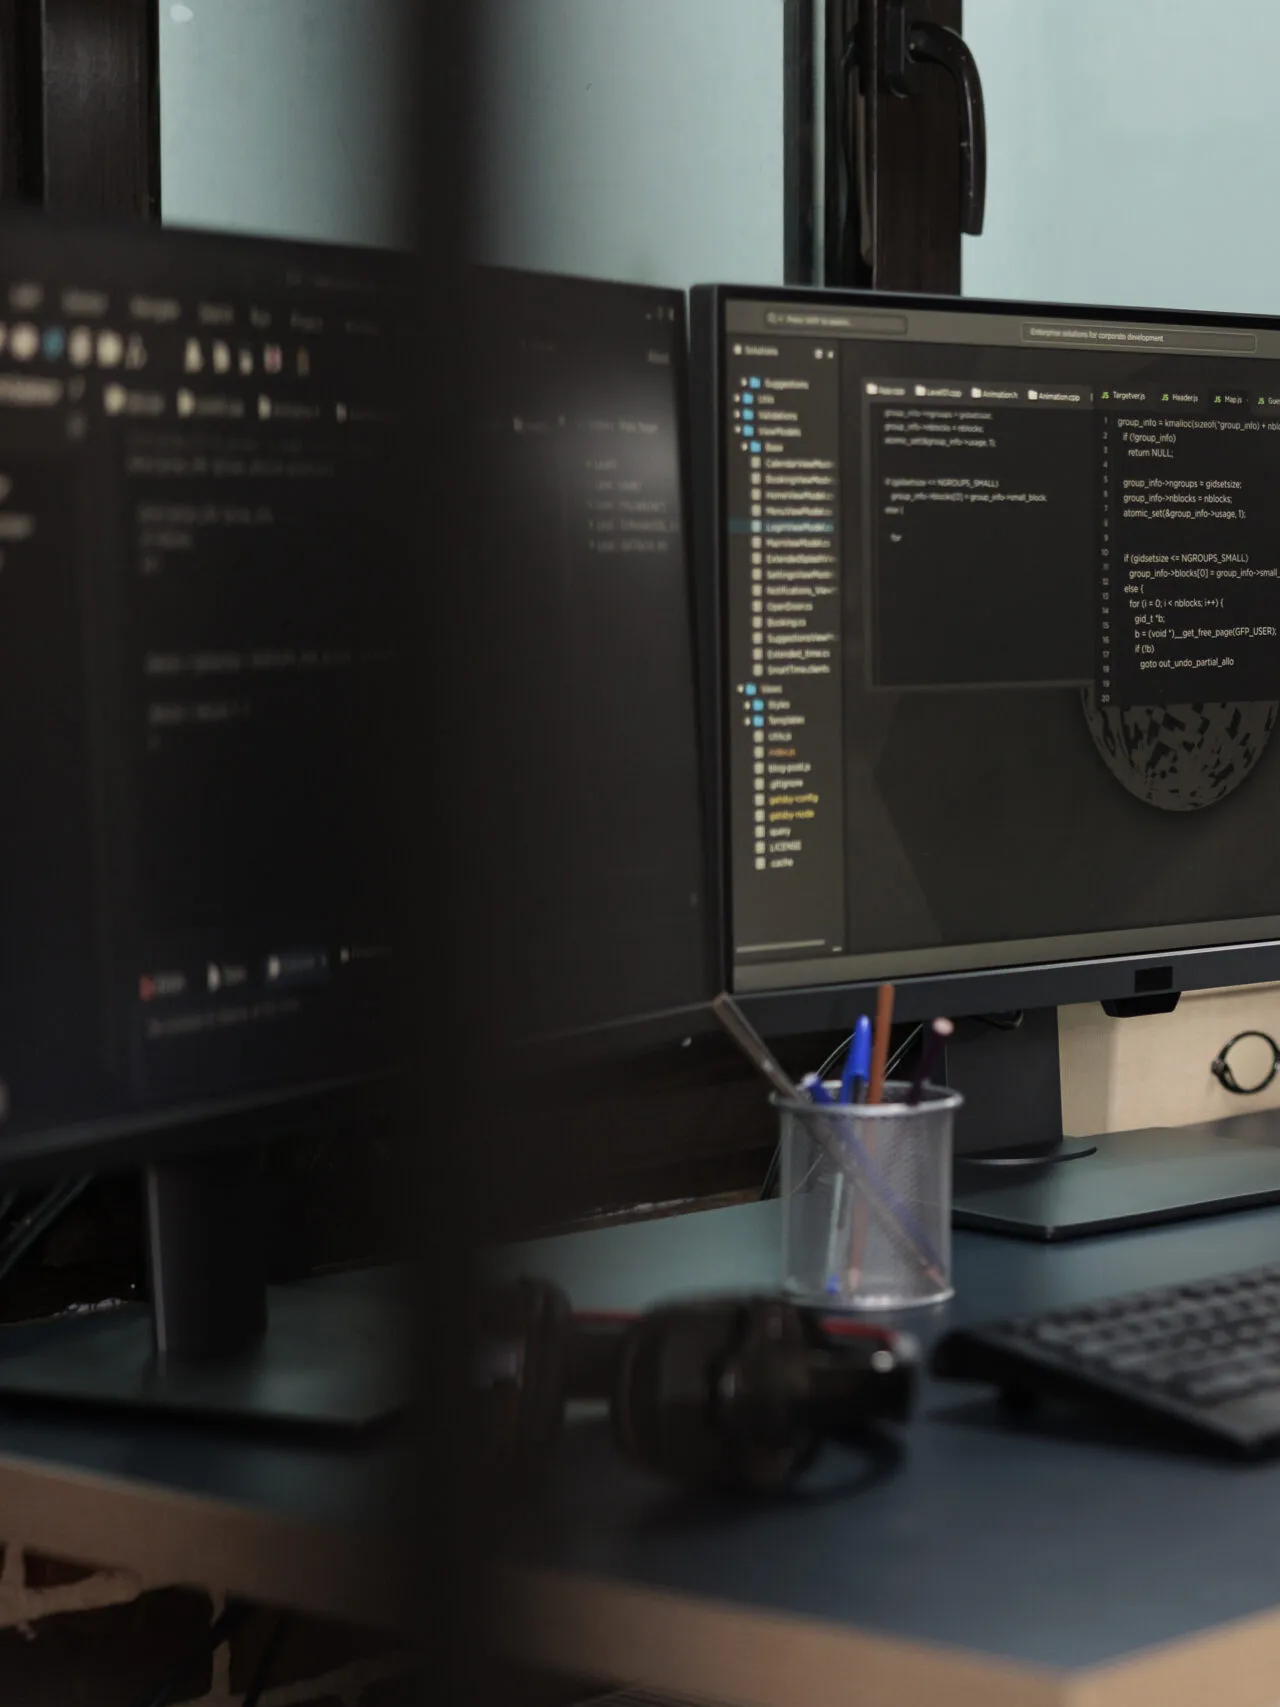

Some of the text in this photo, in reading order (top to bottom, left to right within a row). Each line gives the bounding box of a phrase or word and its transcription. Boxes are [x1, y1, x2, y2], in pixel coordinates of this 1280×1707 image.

[1098, 332, 1126, 340] corporate
[1127, 333, 1164, 342] development
[1172, 394, 1198, 402] Header.js
[1225, 396, 1242, 404] Map.js
[1118, 418, 1156, 428] group_info
[1123, 432, 1128, 441] if
[1152, 448, 1173, 458] NULL;
[1123, 478, 1198, 488] group_info->ngroups
[1206, 480, 1241, 489] gidsetsize;
[1123, 494, 1196, 504] group_info->nblocks
[1204, 494, 1232, 504] nblocks;
[1124, 554, 1129, 562] if
[1131, 554, 1168, 564] (gidsetsize
[1182, 554, 1248, 564] NGROUPS_SMALL)
[1124, 585, 1138, 593] else
[1129, 600, 1140, 608] for
[1174, 599, 1202, 608] nblocks;
[1135, 614, 1153, 624] gid_t
[1135, 630, 1140, 638] b
[1148, 629, 1167, 639] (void
[1135, 644, 1140, 652] if
[1140, 658, 1234, 670] goto out_undo_partial_allo
